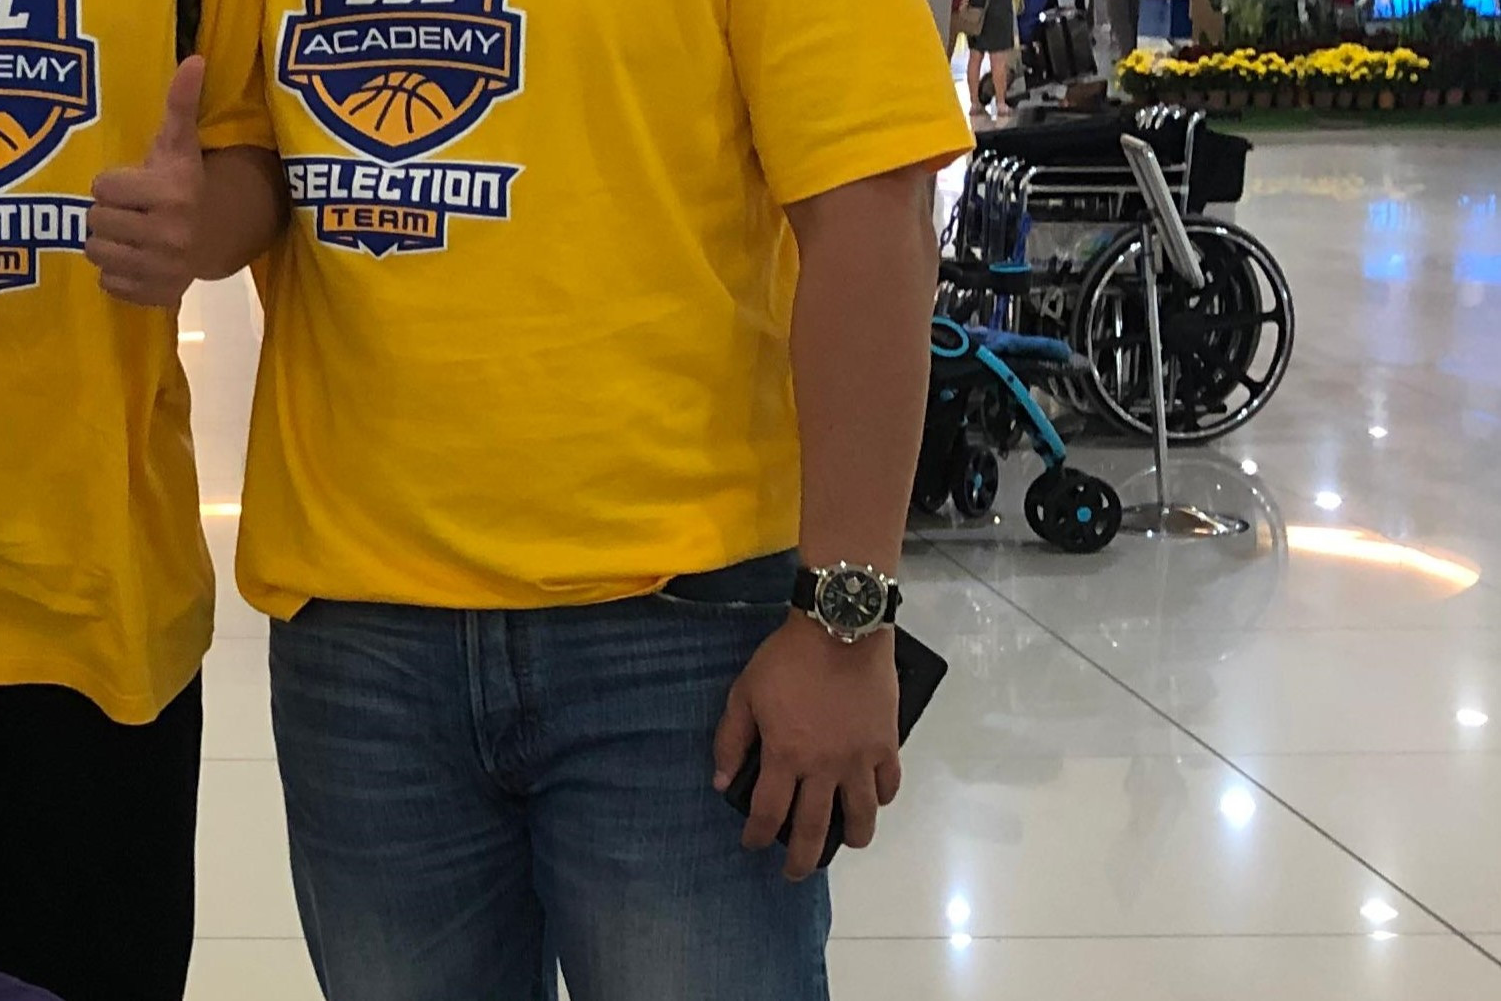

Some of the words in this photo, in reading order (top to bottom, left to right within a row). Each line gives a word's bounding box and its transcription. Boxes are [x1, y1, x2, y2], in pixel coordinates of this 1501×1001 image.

[303, 25, 501, 56] ACADEMY
[288, 164, 502, 210] SELECTION
[331, 207, 430, 234] TEAM
